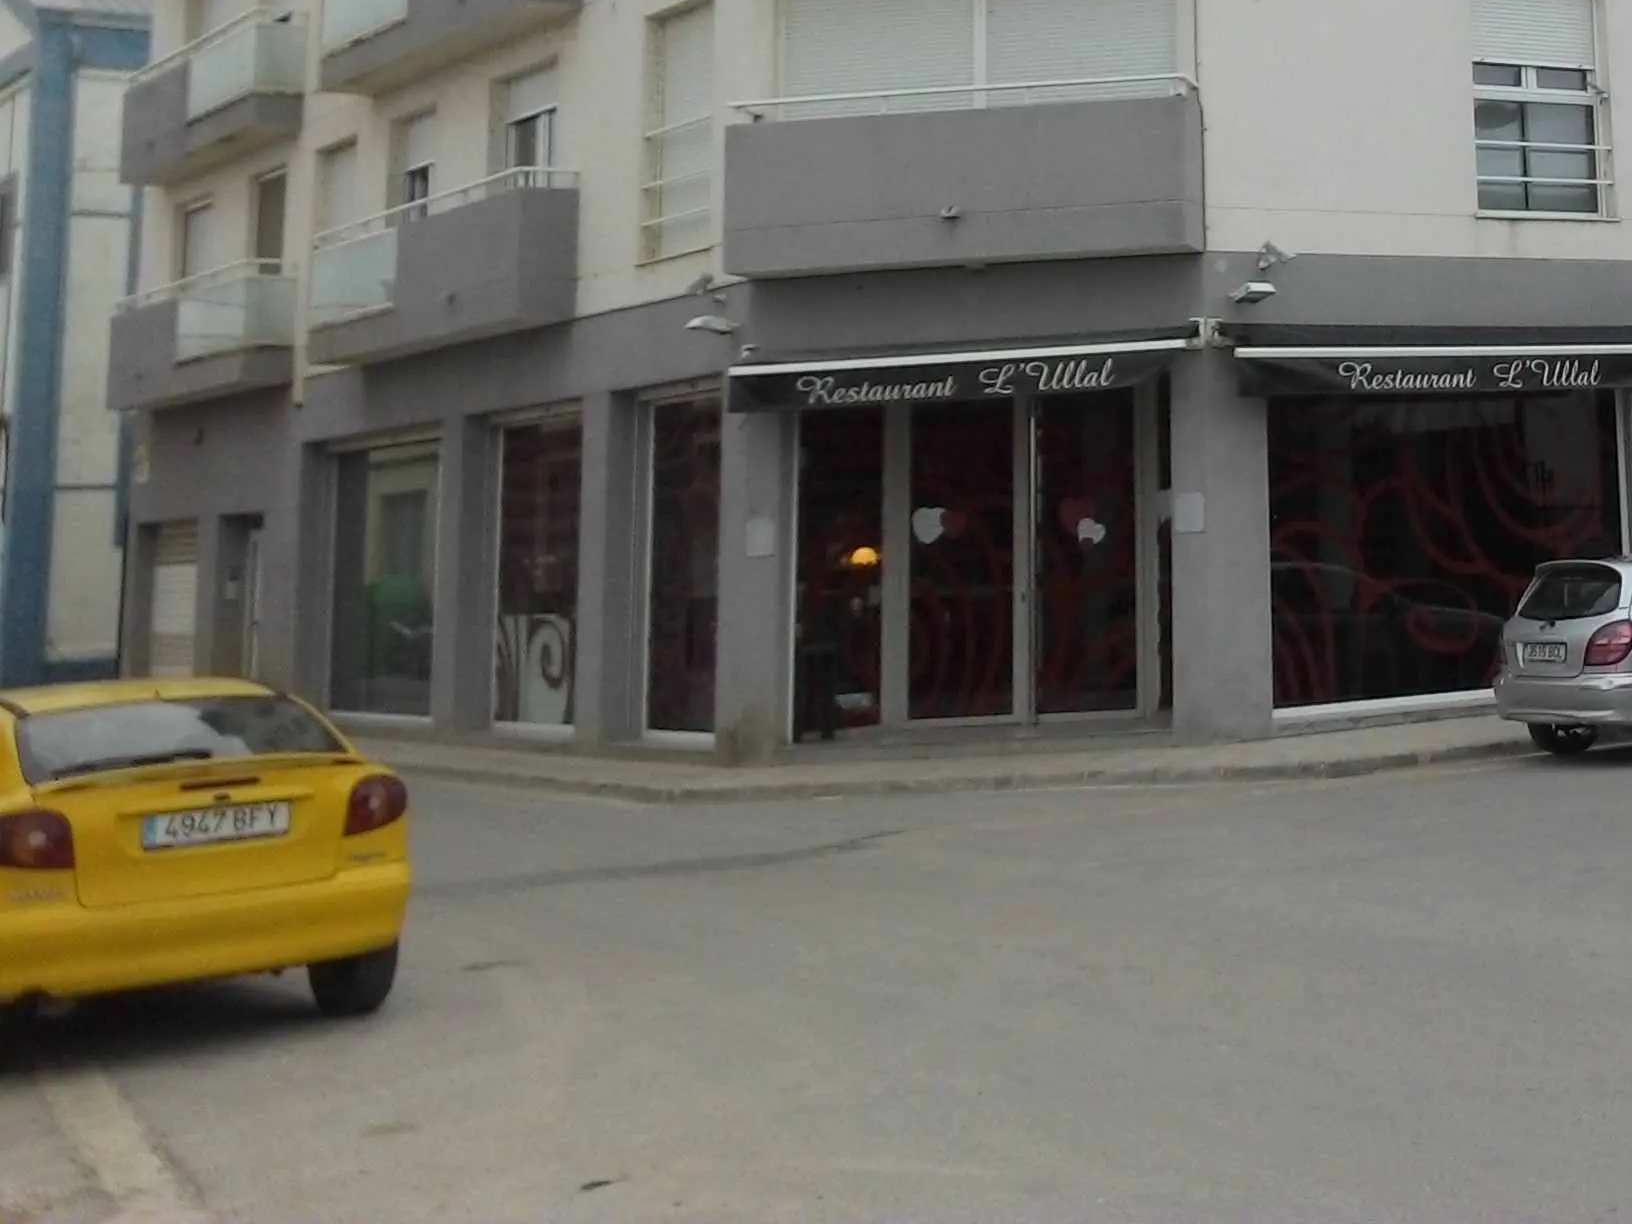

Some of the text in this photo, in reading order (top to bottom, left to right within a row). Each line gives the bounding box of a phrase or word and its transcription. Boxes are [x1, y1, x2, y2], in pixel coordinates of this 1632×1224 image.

[796, 357, 1115, 405] Restaurant L'Ullal
[1338, 359, 1601, 391] Restaurant L'Ullal
